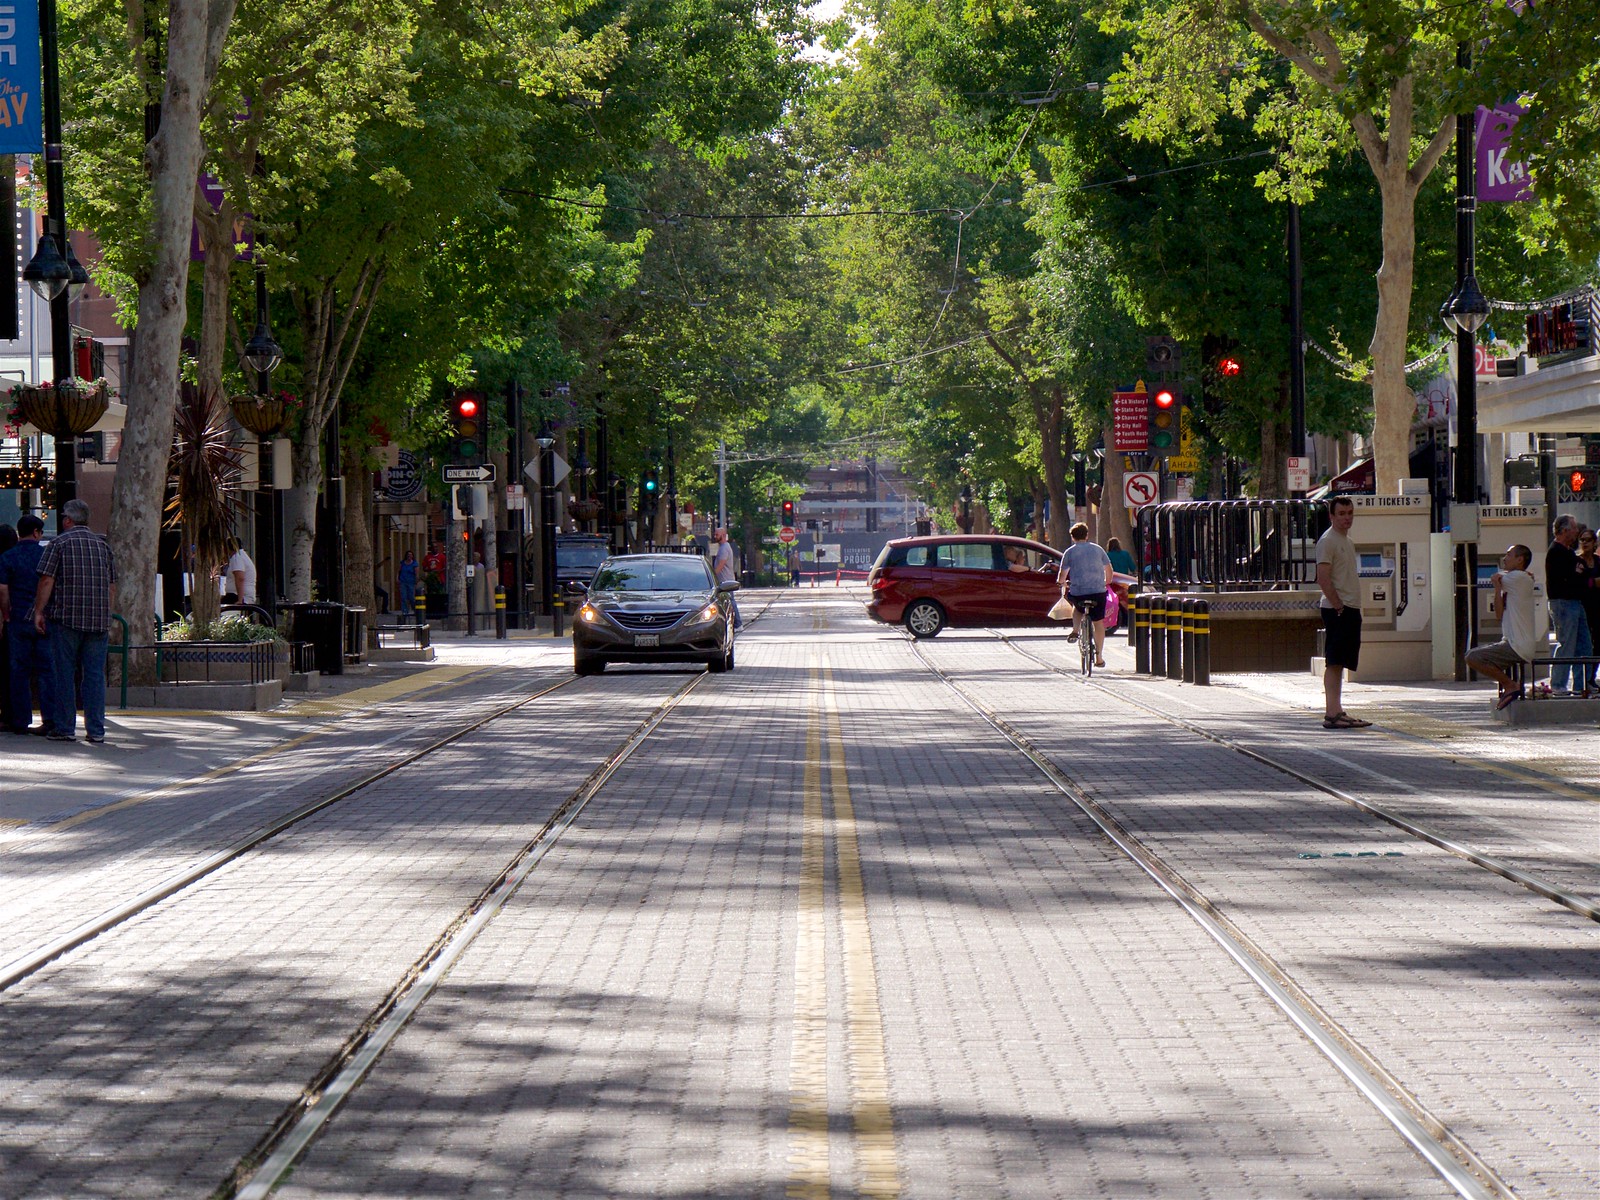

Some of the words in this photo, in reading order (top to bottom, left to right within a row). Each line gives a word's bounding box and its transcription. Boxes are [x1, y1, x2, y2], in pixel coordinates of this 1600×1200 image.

[1488, 147, 1524, 187] KA
[1366, 497, 1375, 506] RT
[1379, 497, 1411, 506] TICKETS
[1482, 508, 1491, 517] RT
[1495, 507, 1527, 517] TICKETS
[844, 555, 871, 564] PROUD
